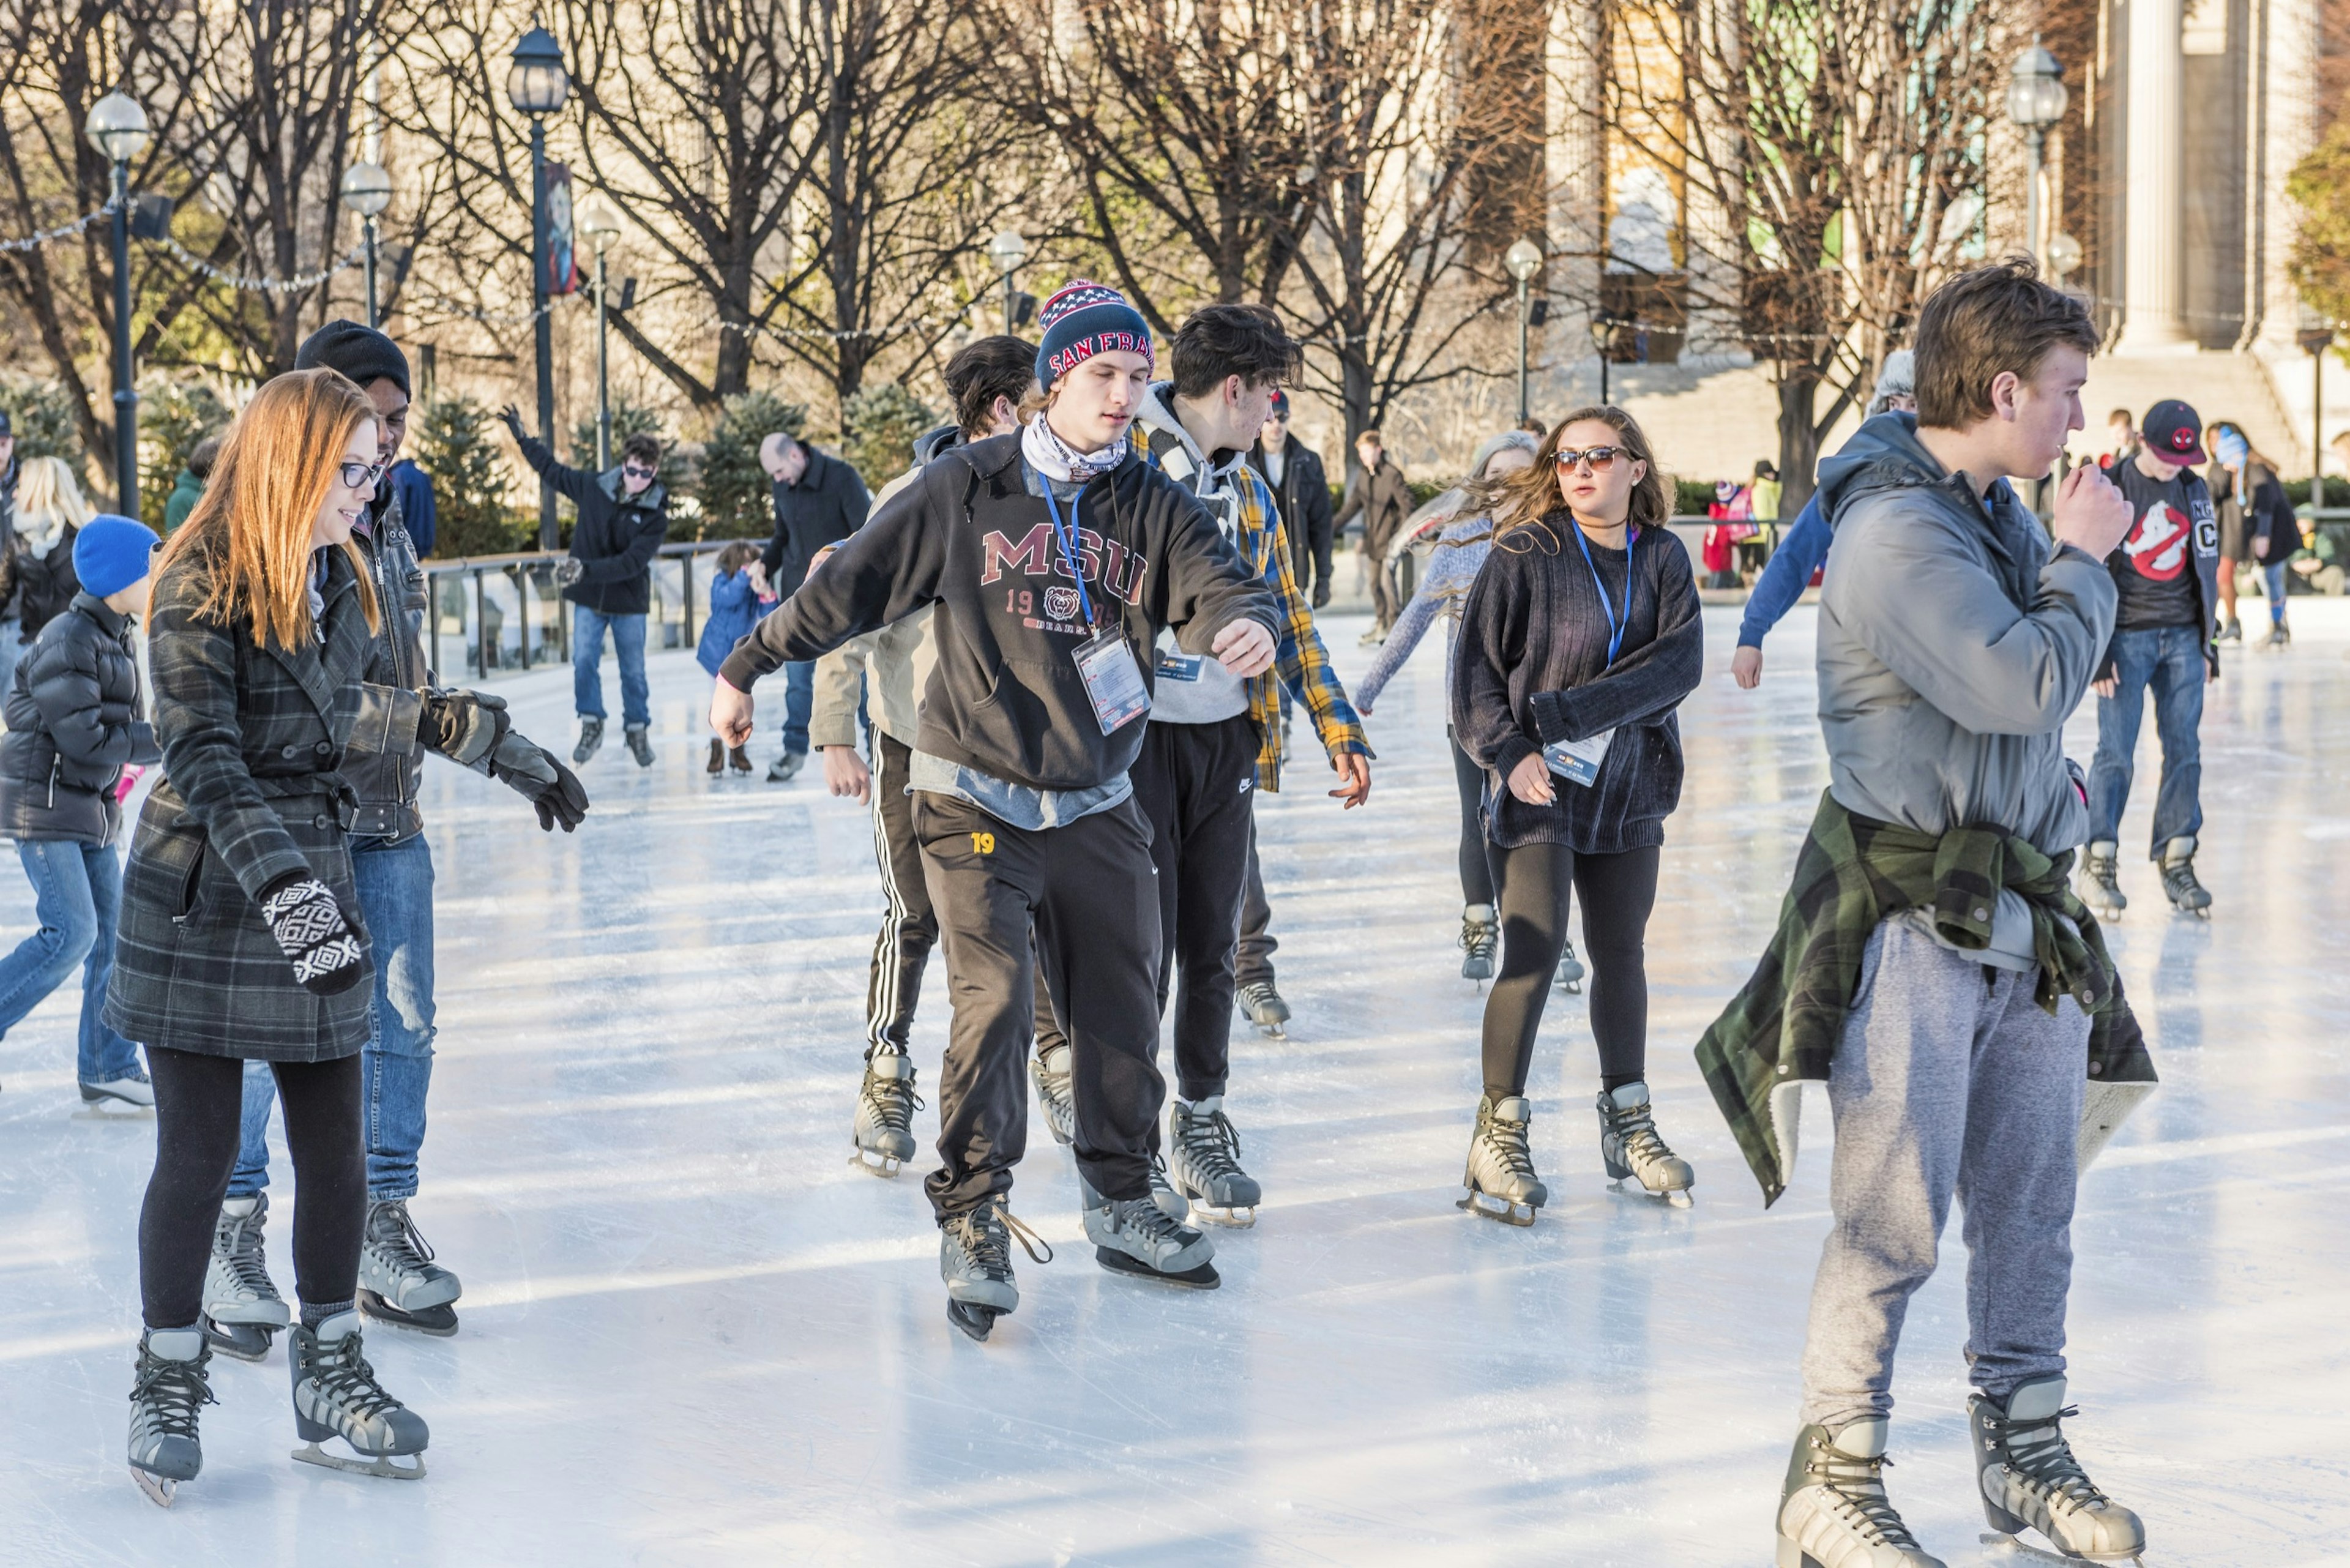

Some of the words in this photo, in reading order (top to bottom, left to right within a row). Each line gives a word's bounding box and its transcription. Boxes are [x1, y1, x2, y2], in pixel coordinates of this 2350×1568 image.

[1049, 338, 1094, 378] SAN
[981, 523, 1149, 606] MSU
[1006, 589, 1033, 616] 19
[971, 832, 995, 854] 19
